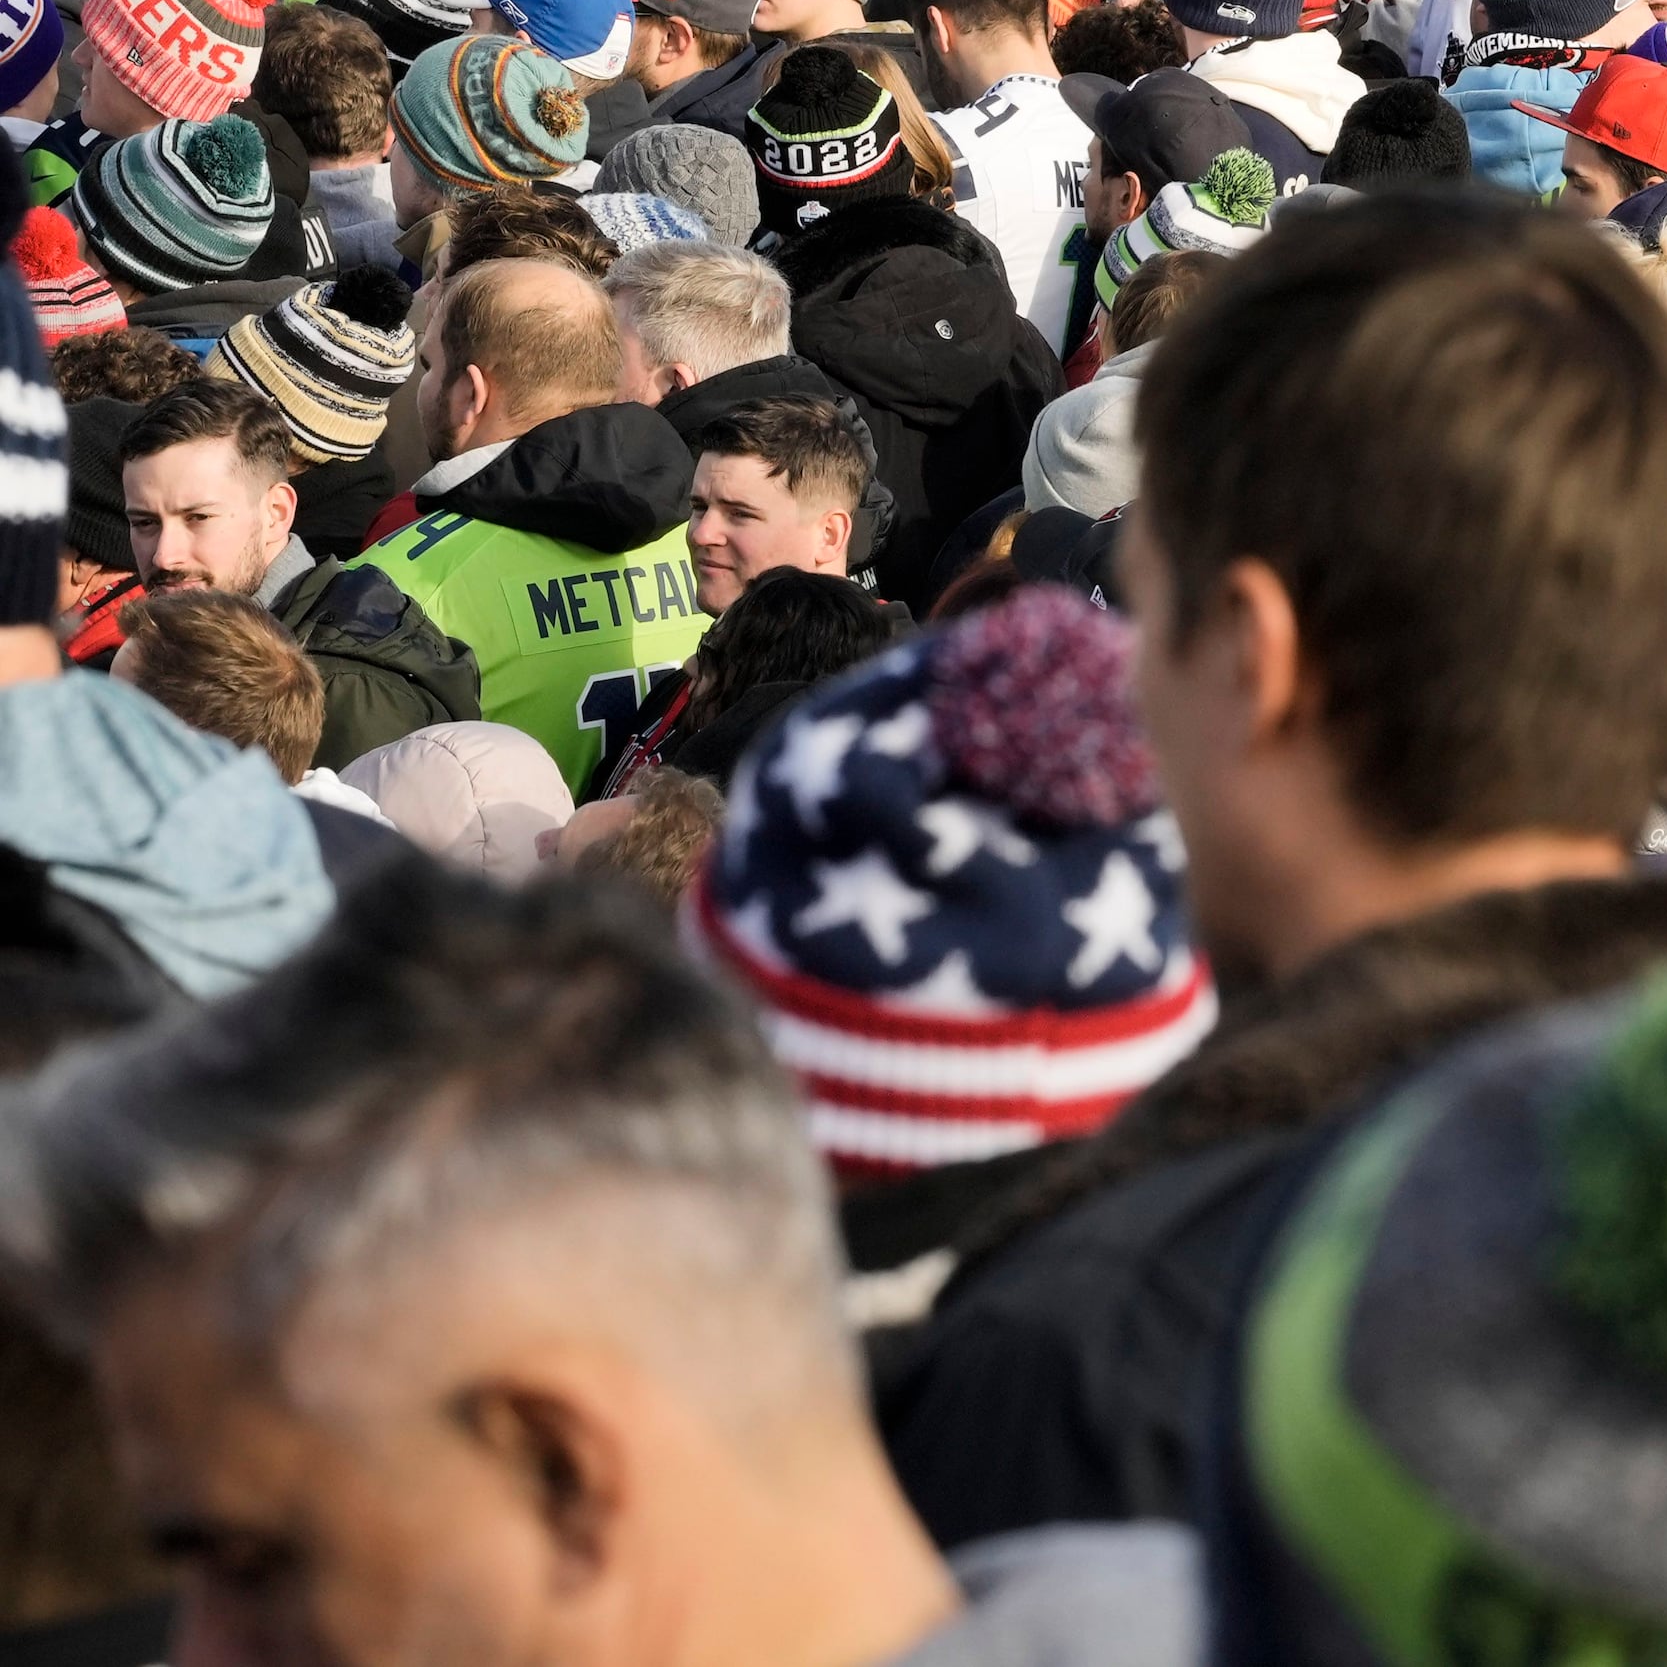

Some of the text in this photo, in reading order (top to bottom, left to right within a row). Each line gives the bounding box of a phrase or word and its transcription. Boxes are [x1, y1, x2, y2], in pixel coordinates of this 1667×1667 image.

[765, 131, 880, 176] 2022
[1053, 159, 1093, 209] ME
[303, 215, 335, 271] DY
